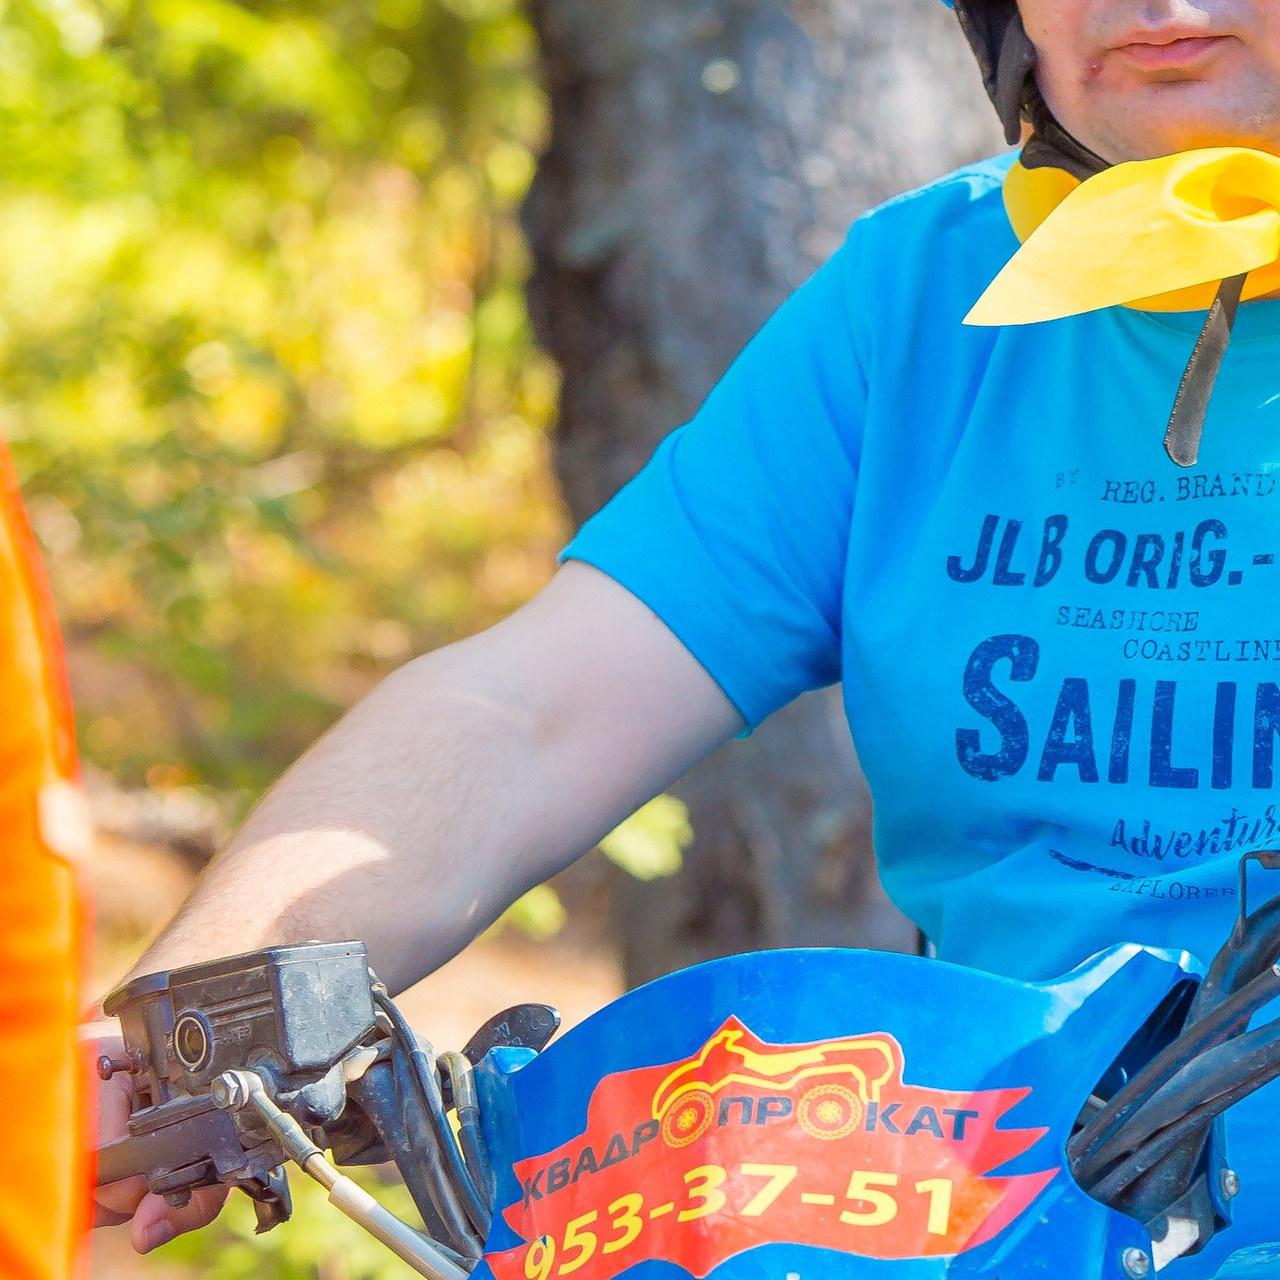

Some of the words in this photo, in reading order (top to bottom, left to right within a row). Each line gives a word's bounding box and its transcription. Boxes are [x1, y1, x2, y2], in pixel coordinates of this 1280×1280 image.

[1101, 479, 1165, 504] REG.
[1176, 473, 1276, 502] BRAND
[945, 513, 1070, 589] JLB
[1056, 605, 1200, 632] SEASHORE
[1108, 880, 1236, 901] EXPLORER
